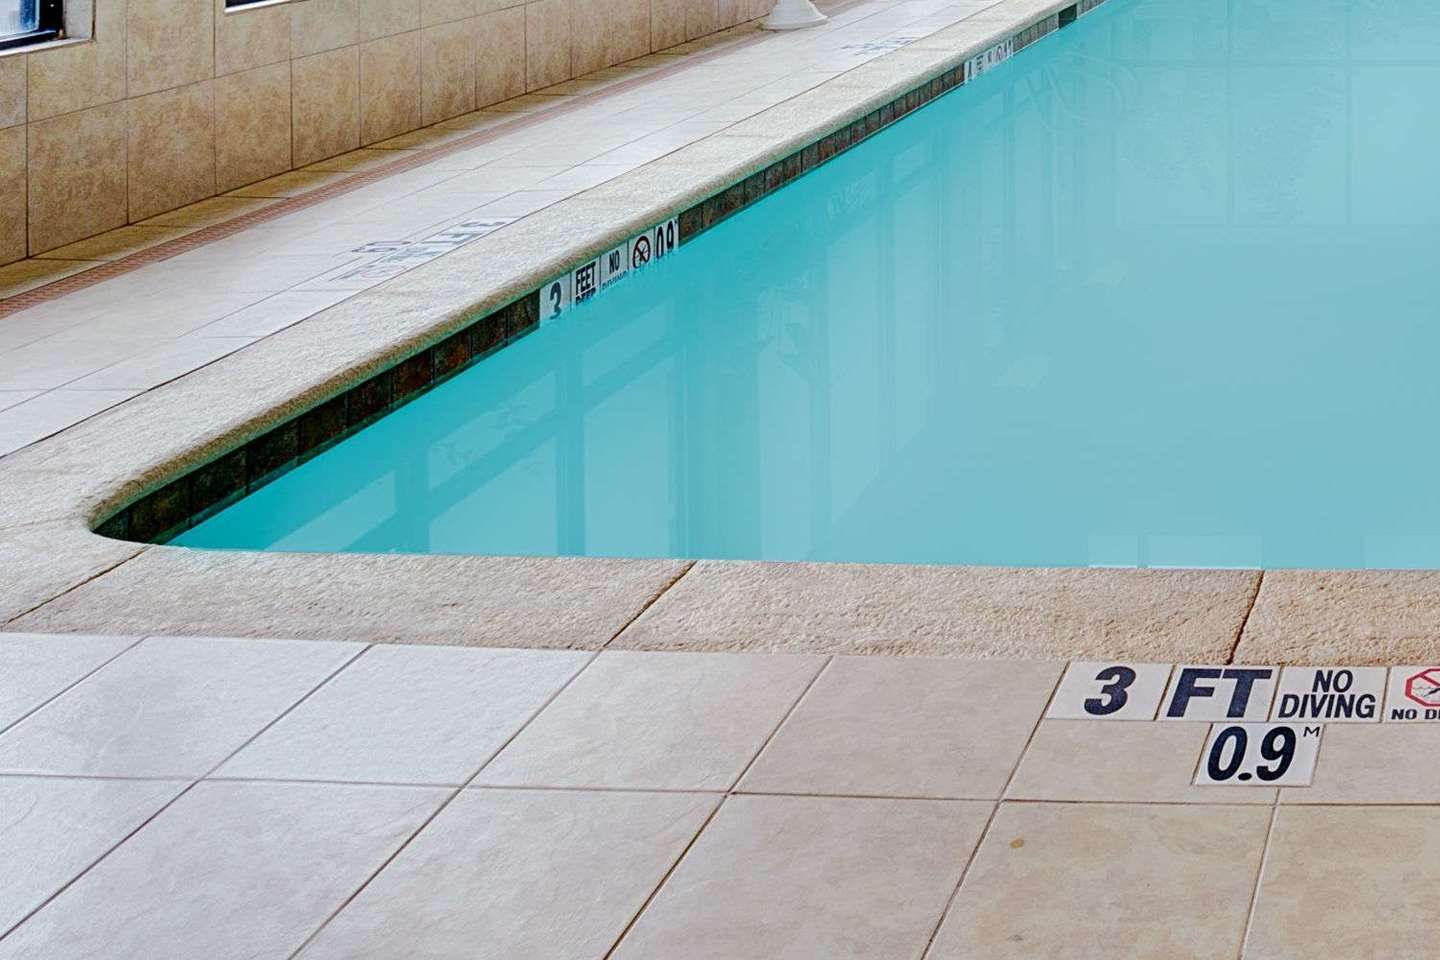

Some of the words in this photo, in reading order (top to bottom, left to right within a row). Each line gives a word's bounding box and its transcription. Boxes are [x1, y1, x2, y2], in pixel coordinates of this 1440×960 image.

[549, 282, 562, 320] 3
[575, 261, 596, 296] FEET
[609, 250, 620, 275] NO
[1084, 665, 1137, 716] 3
[1166, 667, 1272, 718] FT
[1312, 669, 1354, 694] NO
[1278, 693, 1377, 719] DIVING
[1390, 708, 1421, 720] NO
[1206, 726, 1297, 782] 0.9
[1303, 726, 1321, 738] M
